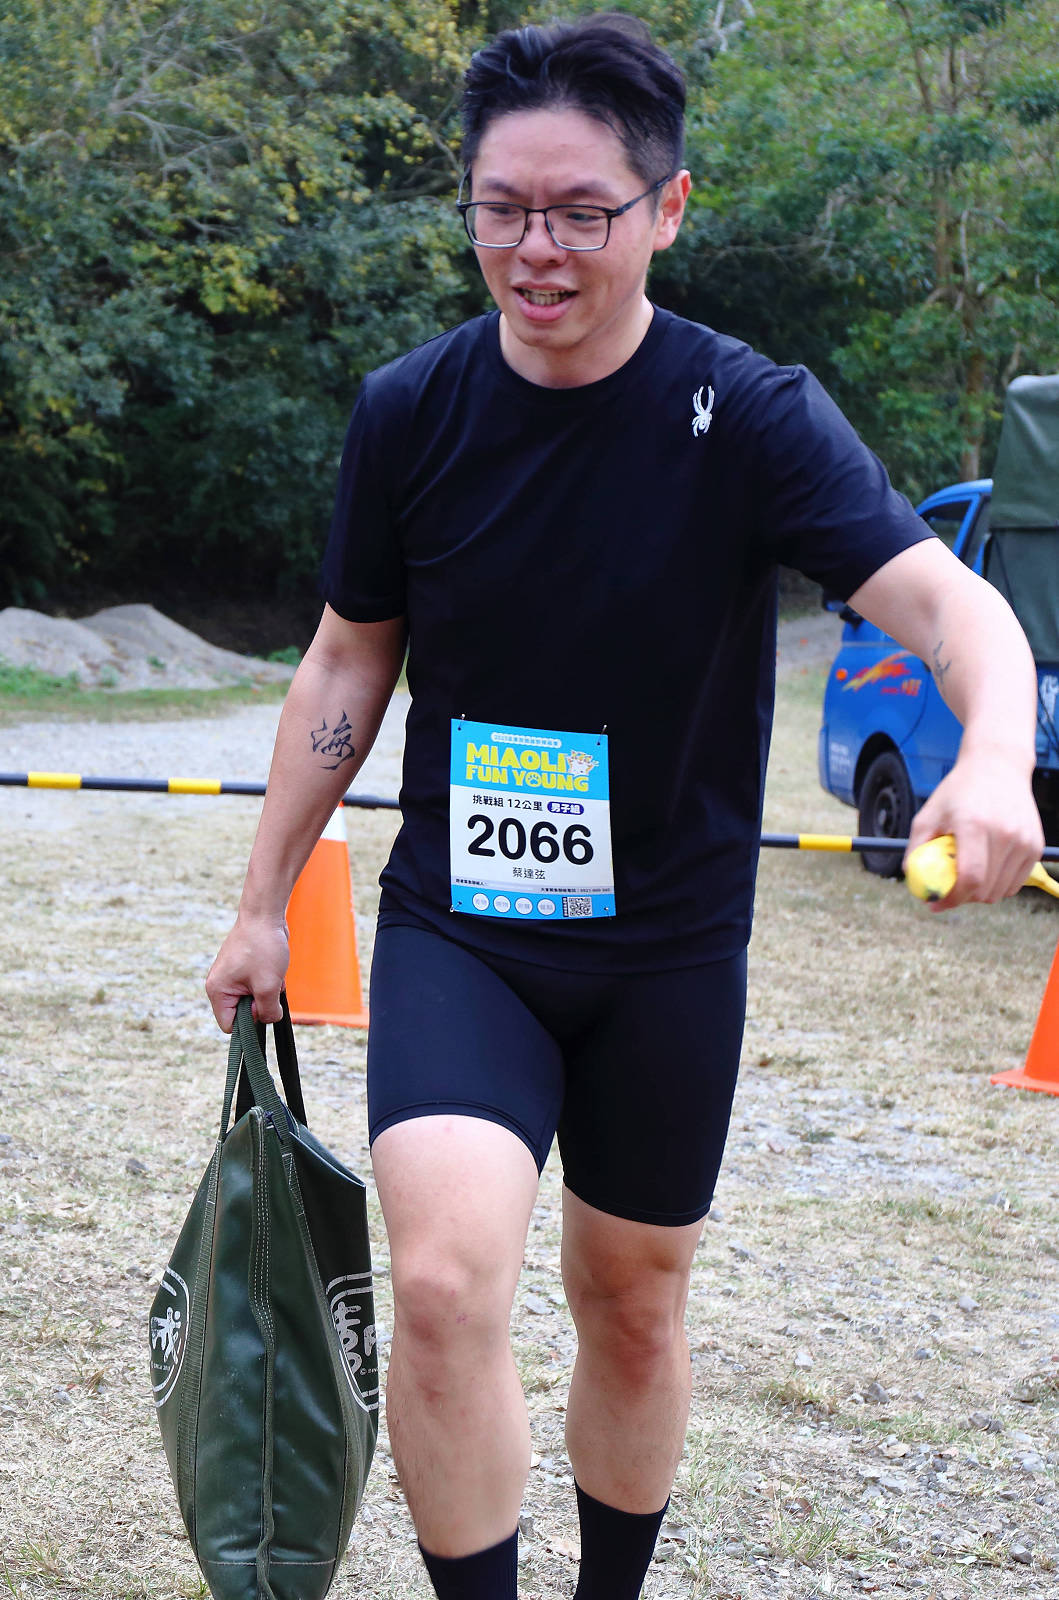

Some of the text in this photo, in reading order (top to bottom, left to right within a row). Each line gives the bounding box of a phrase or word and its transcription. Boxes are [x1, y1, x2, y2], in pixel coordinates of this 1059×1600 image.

[466, 742, 567, 773] MIAOLI
[465, 764, 589, 792] FUN YOUNG
[472, 794, 543, 811] 挑戰組 12公里
[550, 802, 581, 815] 男子組
[467, 814, 594, 866] 2066
